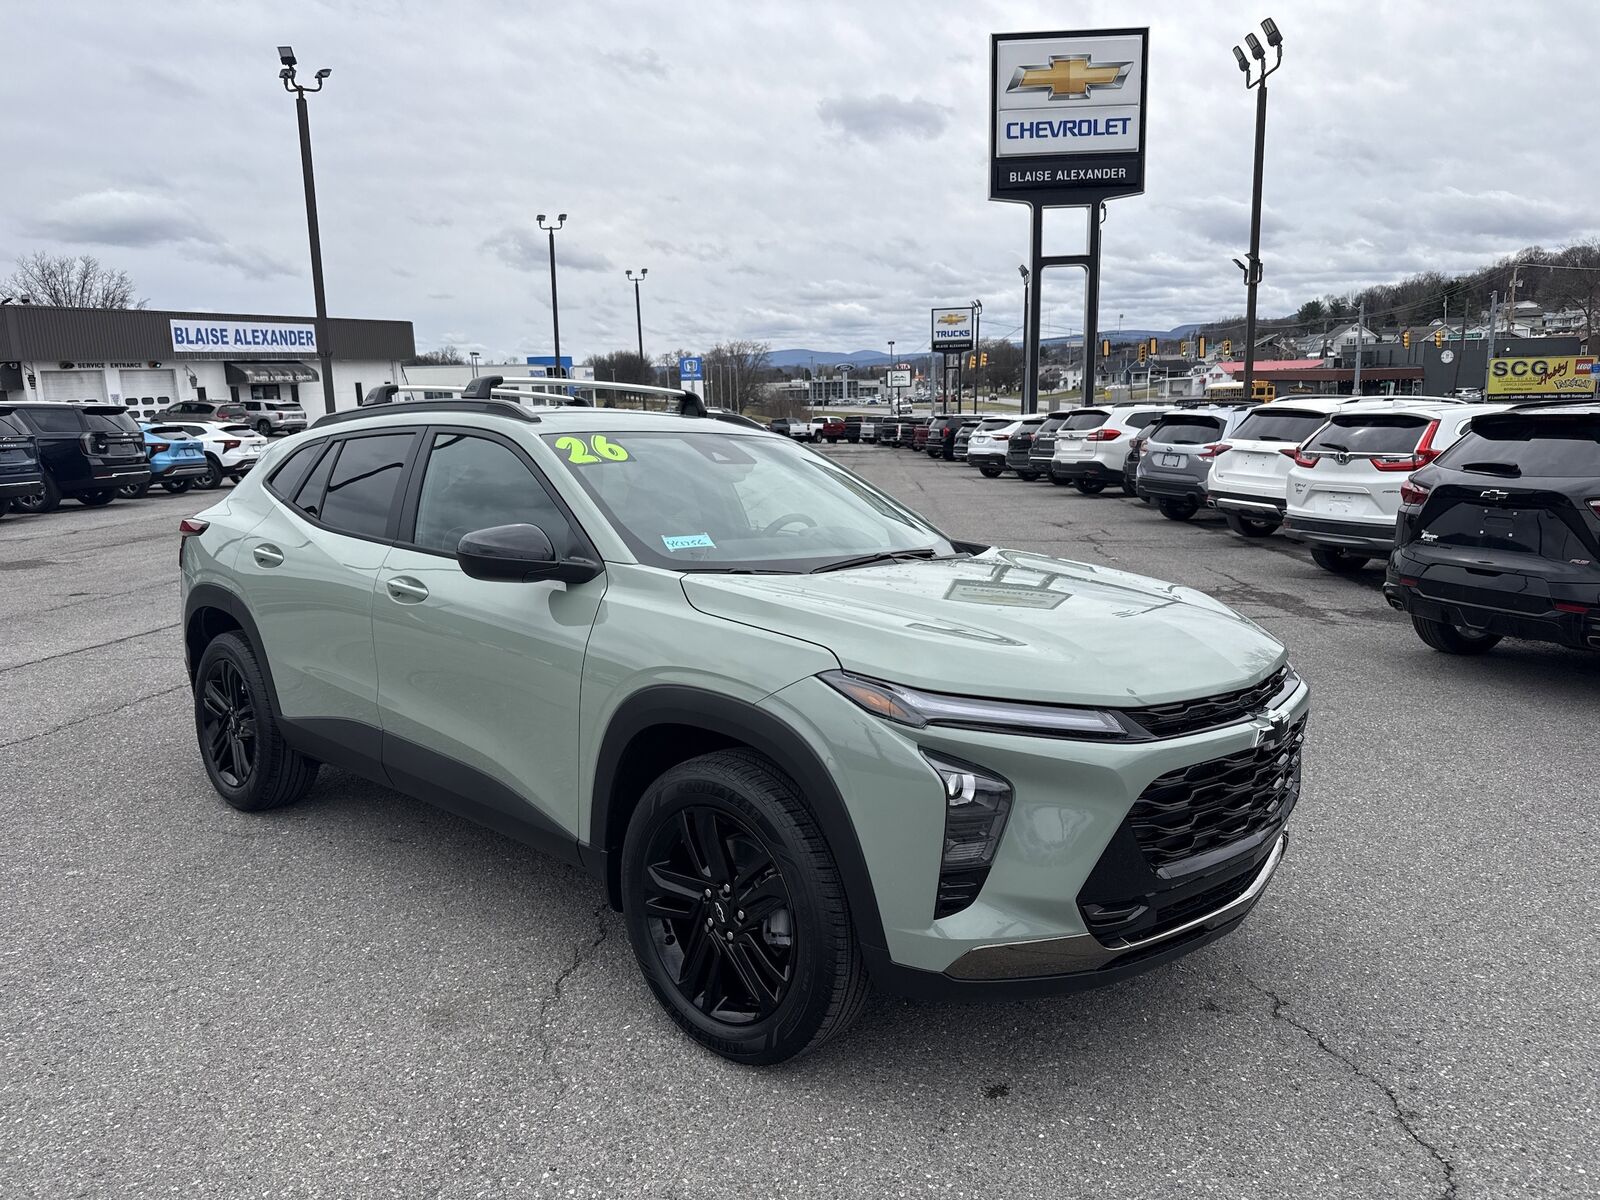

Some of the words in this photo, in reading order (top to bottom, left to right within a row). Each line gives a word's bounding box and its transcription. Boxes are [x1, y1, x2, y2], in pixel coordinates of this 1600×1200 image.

[1006, 118, 1131, 139] CHEVROLET
[1009, 171, 1052, 182] BLAISE
[1056, 168, 1126, 181] ALEXANDER
[174, 327, 229, 345] BLAISE
[234, 329, 315, 346] ALEXANDER
[936, 330, 970, 338] TRUCKS
[1493, 361, 1548, 376] SCG
[1537, 361, 1568, 385] Hobby
[555, 434, 629, 464] 26
